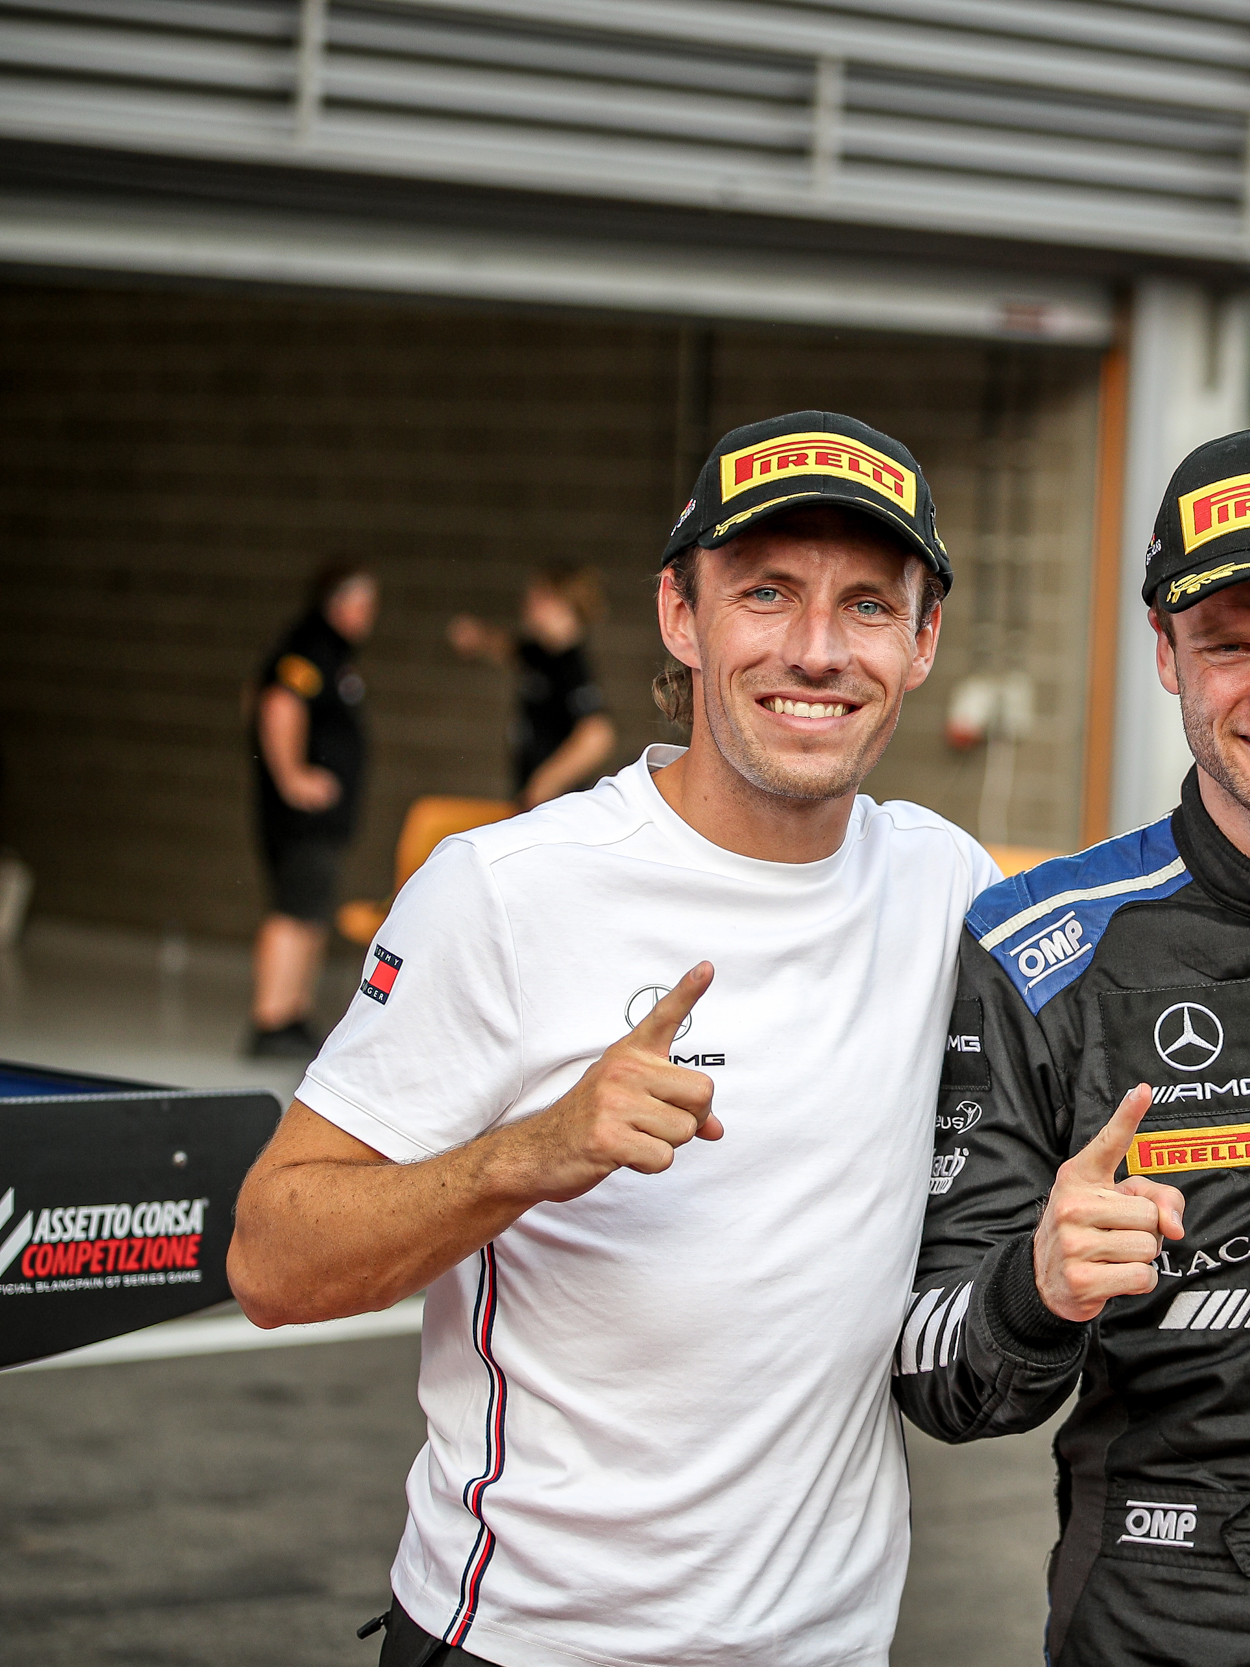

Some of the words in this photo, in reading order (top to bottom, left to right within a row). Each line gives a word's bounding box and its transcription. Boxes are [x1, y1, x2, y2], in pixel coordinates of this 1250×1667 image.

[735, 440, 905, 498] PIRELLI
[1018, 919, 1083, 977] OMP
[947, 1035, 981, 1052] MG
[32, 1203, 132, 1244] ASSETTO
[131, 1199, 204, 1237] CORSA
[21, 1234, 202, 1278] COMPETIZIONE
[35, 1276, 104, 1293] BLANCPAIN
[1125, 1508, 1197, 1541] OMP
